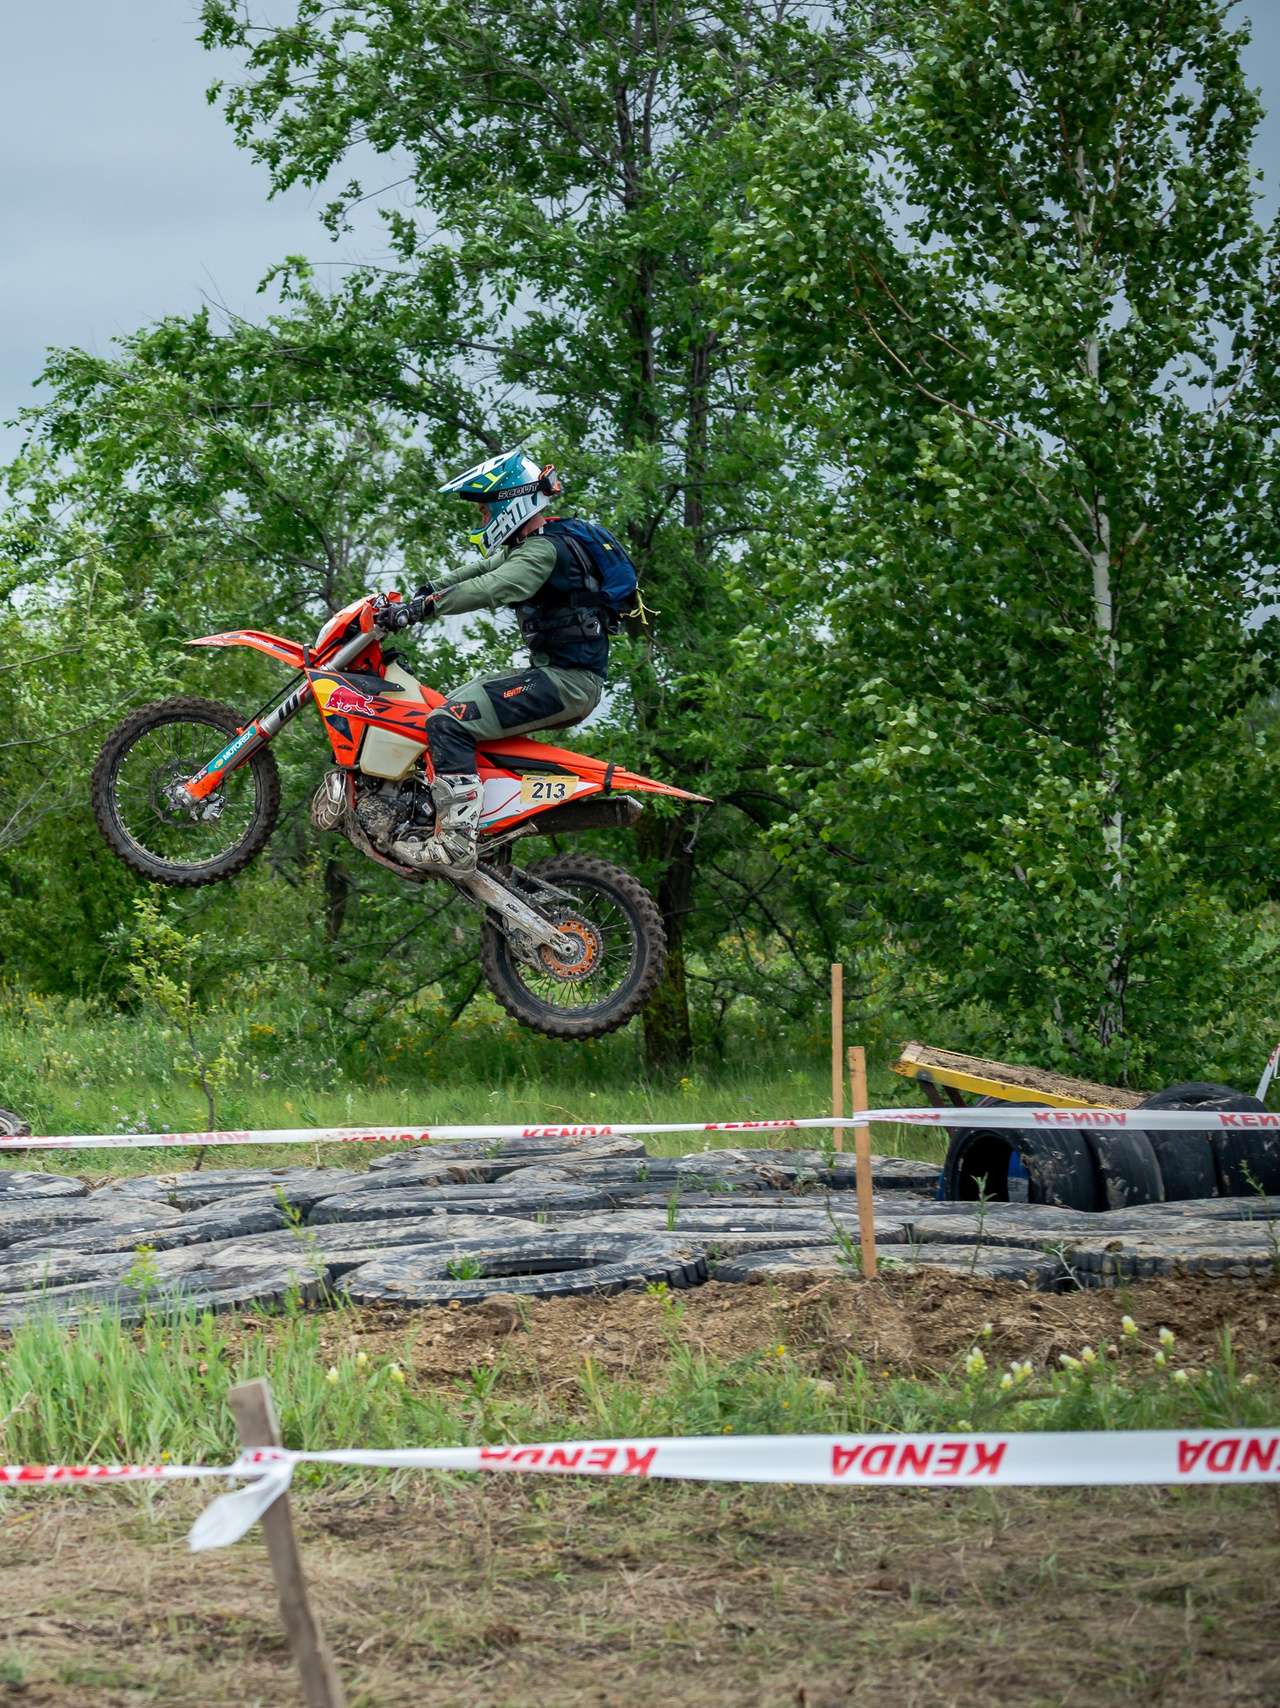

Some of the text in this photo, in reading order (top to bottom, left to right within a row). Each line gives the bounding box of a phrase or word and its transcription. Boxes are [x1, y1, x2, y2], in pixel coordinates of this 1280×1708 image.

[498, 482, 539, 499] SCOUT
[222, 730, 253, 761] MOTOREX
[531, 782, 566, 799] 213
[832, 1442, 1008, 1477] KENDA
